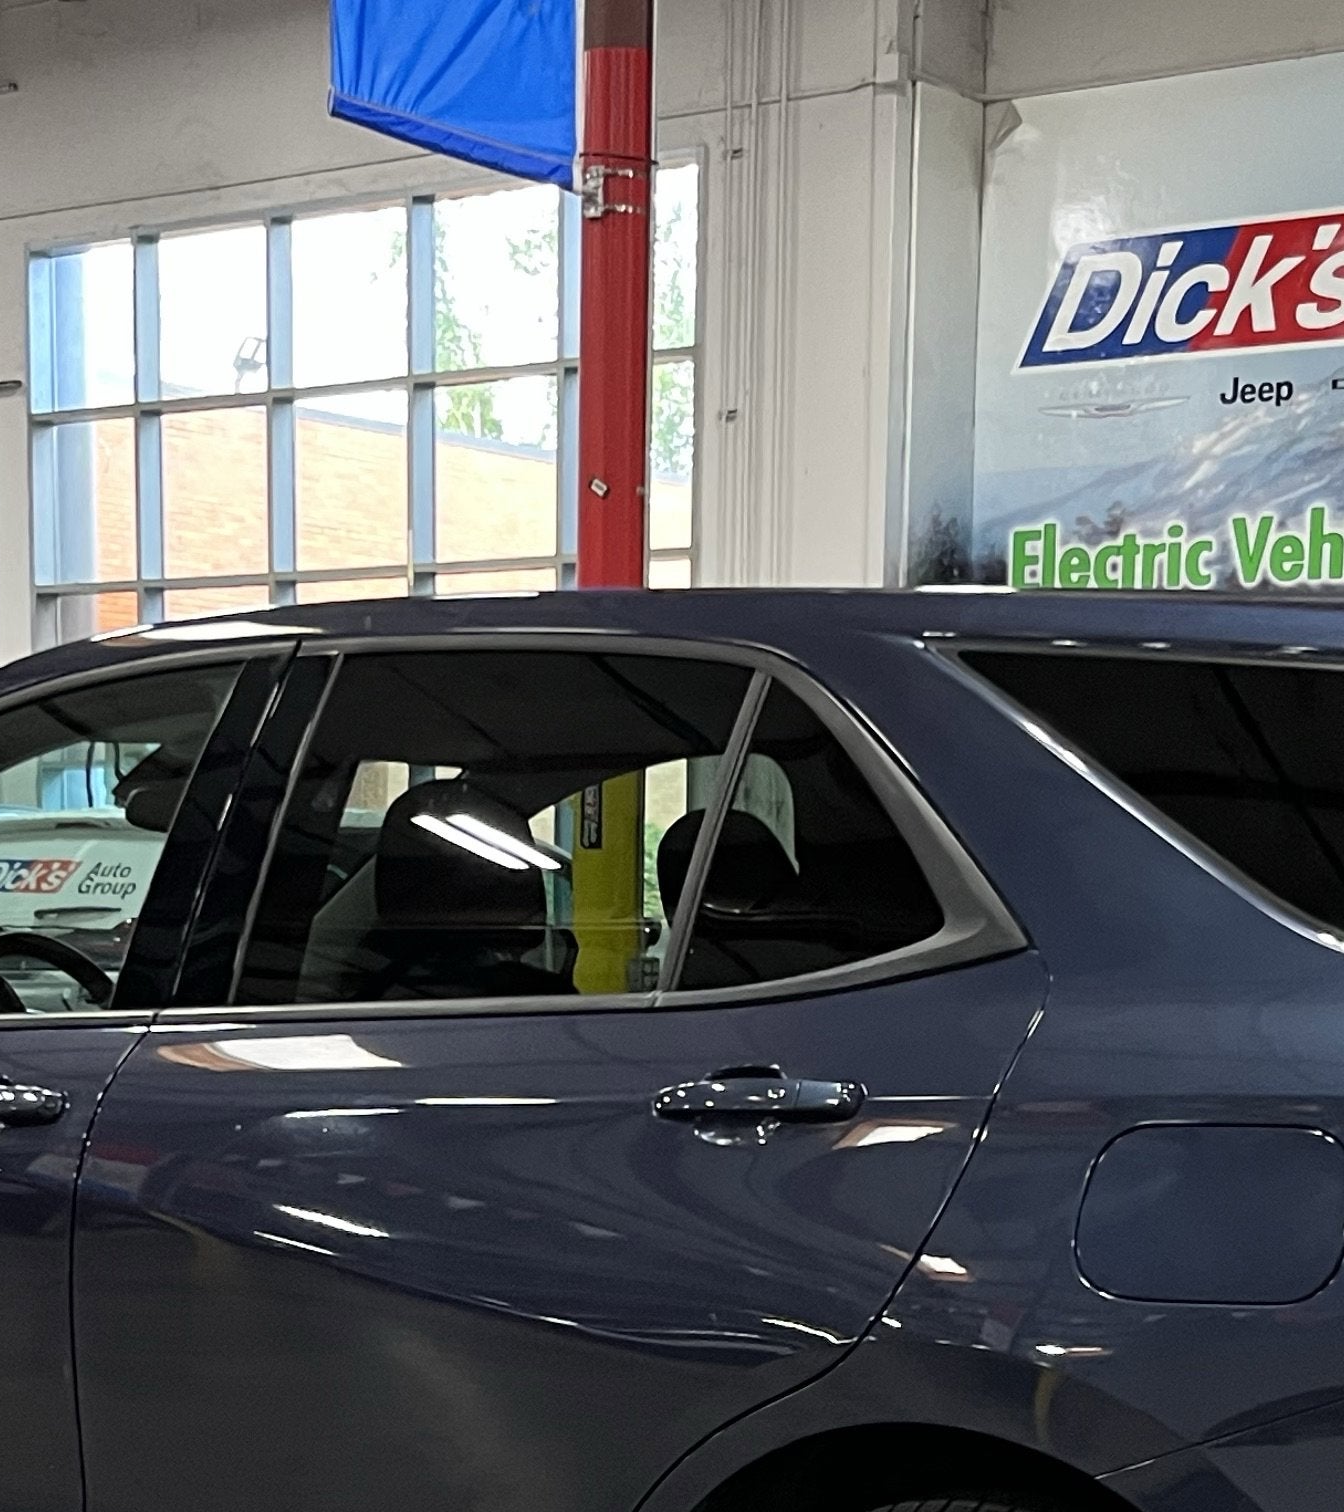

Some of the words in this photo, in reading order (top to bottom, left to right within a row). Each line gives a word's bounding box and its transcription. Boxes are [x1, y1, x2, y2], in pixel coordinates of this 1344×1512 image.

[1219, 377, 1295, 406] Jeep
[1012, 523, 1214, 590] Electric
[87, 862, 132, 879] Auto
[77, 873, 137, 899] Group
